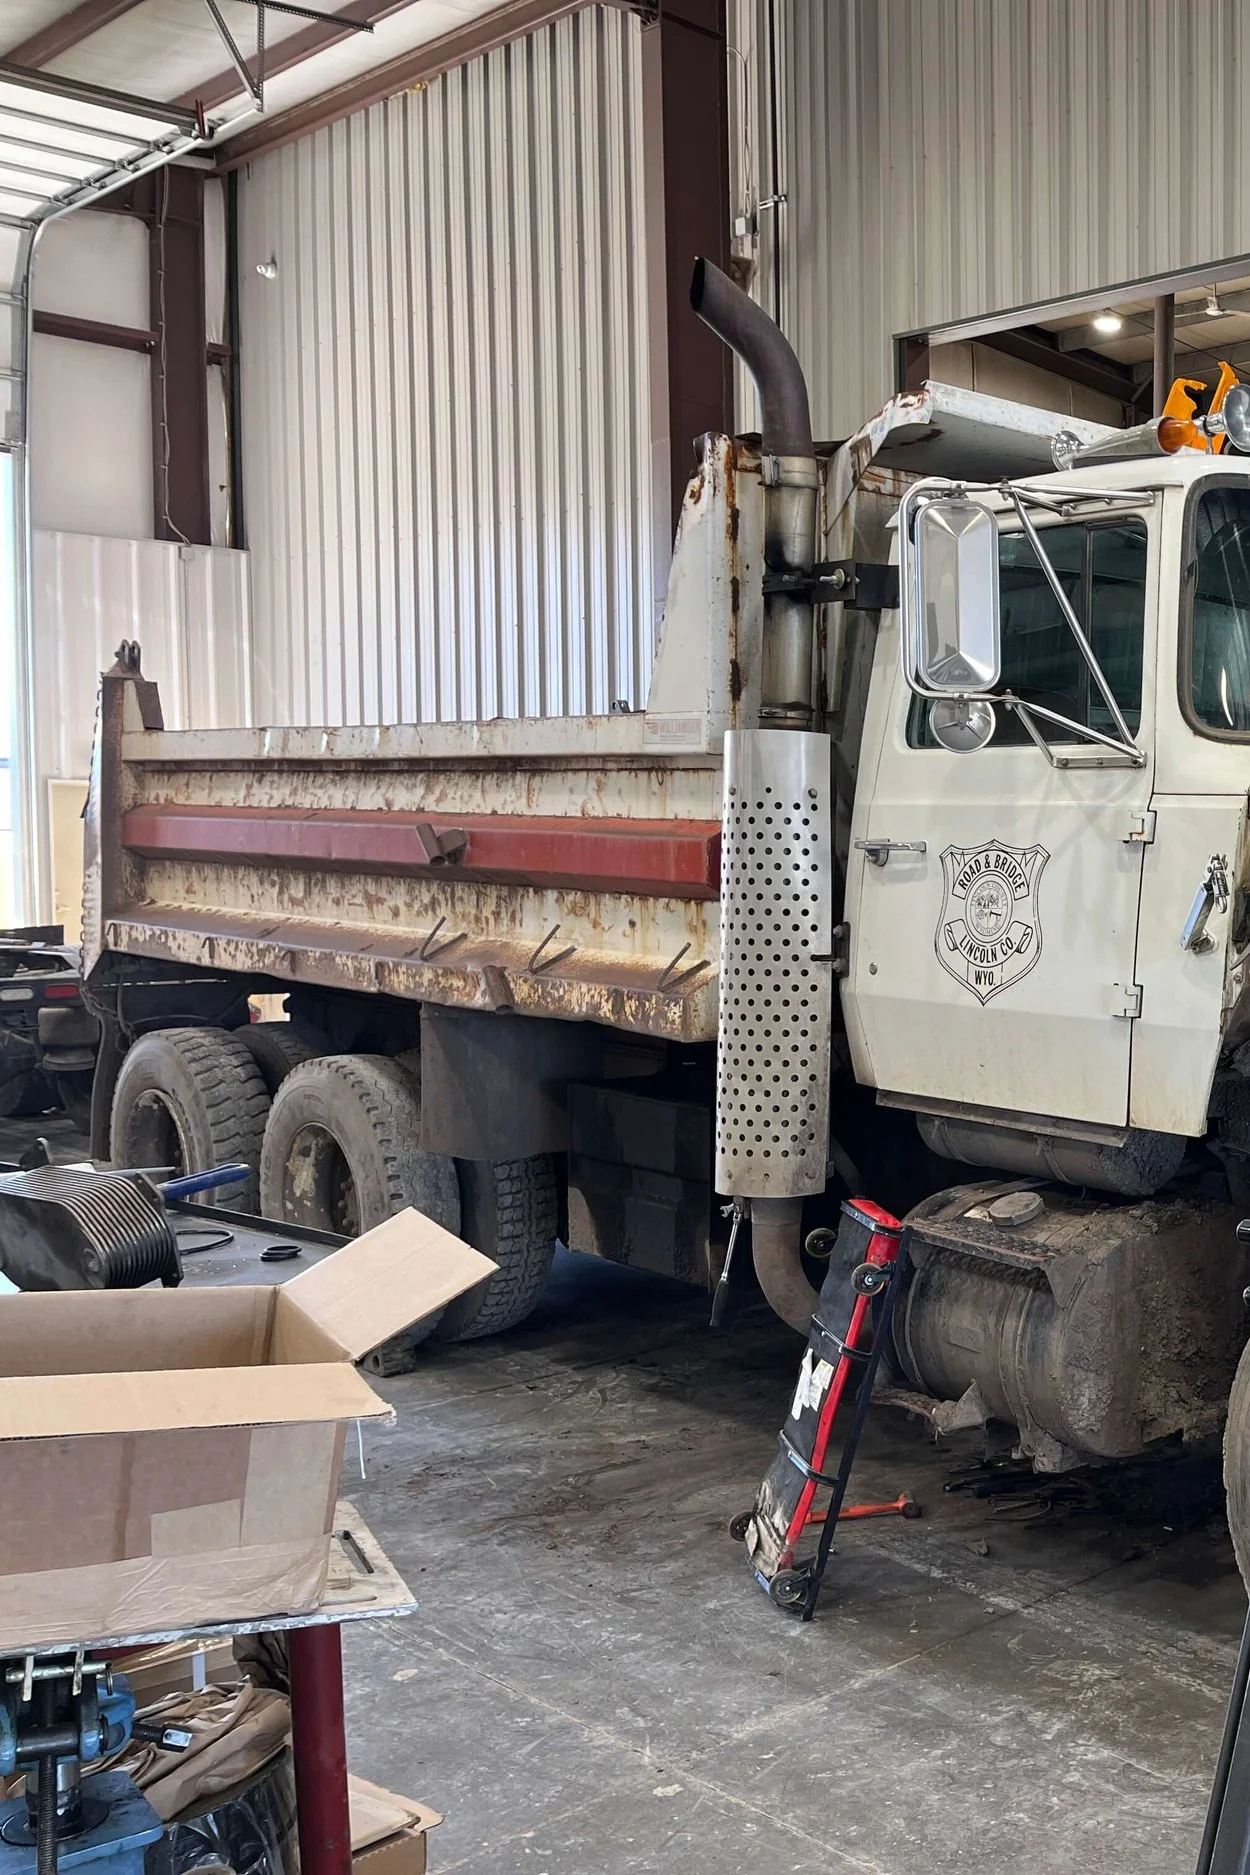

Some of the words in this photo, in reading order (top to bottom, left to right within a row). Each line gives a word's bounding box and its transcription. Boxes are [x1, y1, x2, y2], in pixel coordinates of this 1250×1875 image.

[958, 859, 982, 891] ROAD
[984, 854, 991, 869] &
[994, 854, 1026, 893] BRIDGE
[959, 935, 998, 964] LINCOLN
[1000, 936, 1017, 956] CO.
[974, 969, 996, 987] WYO.
